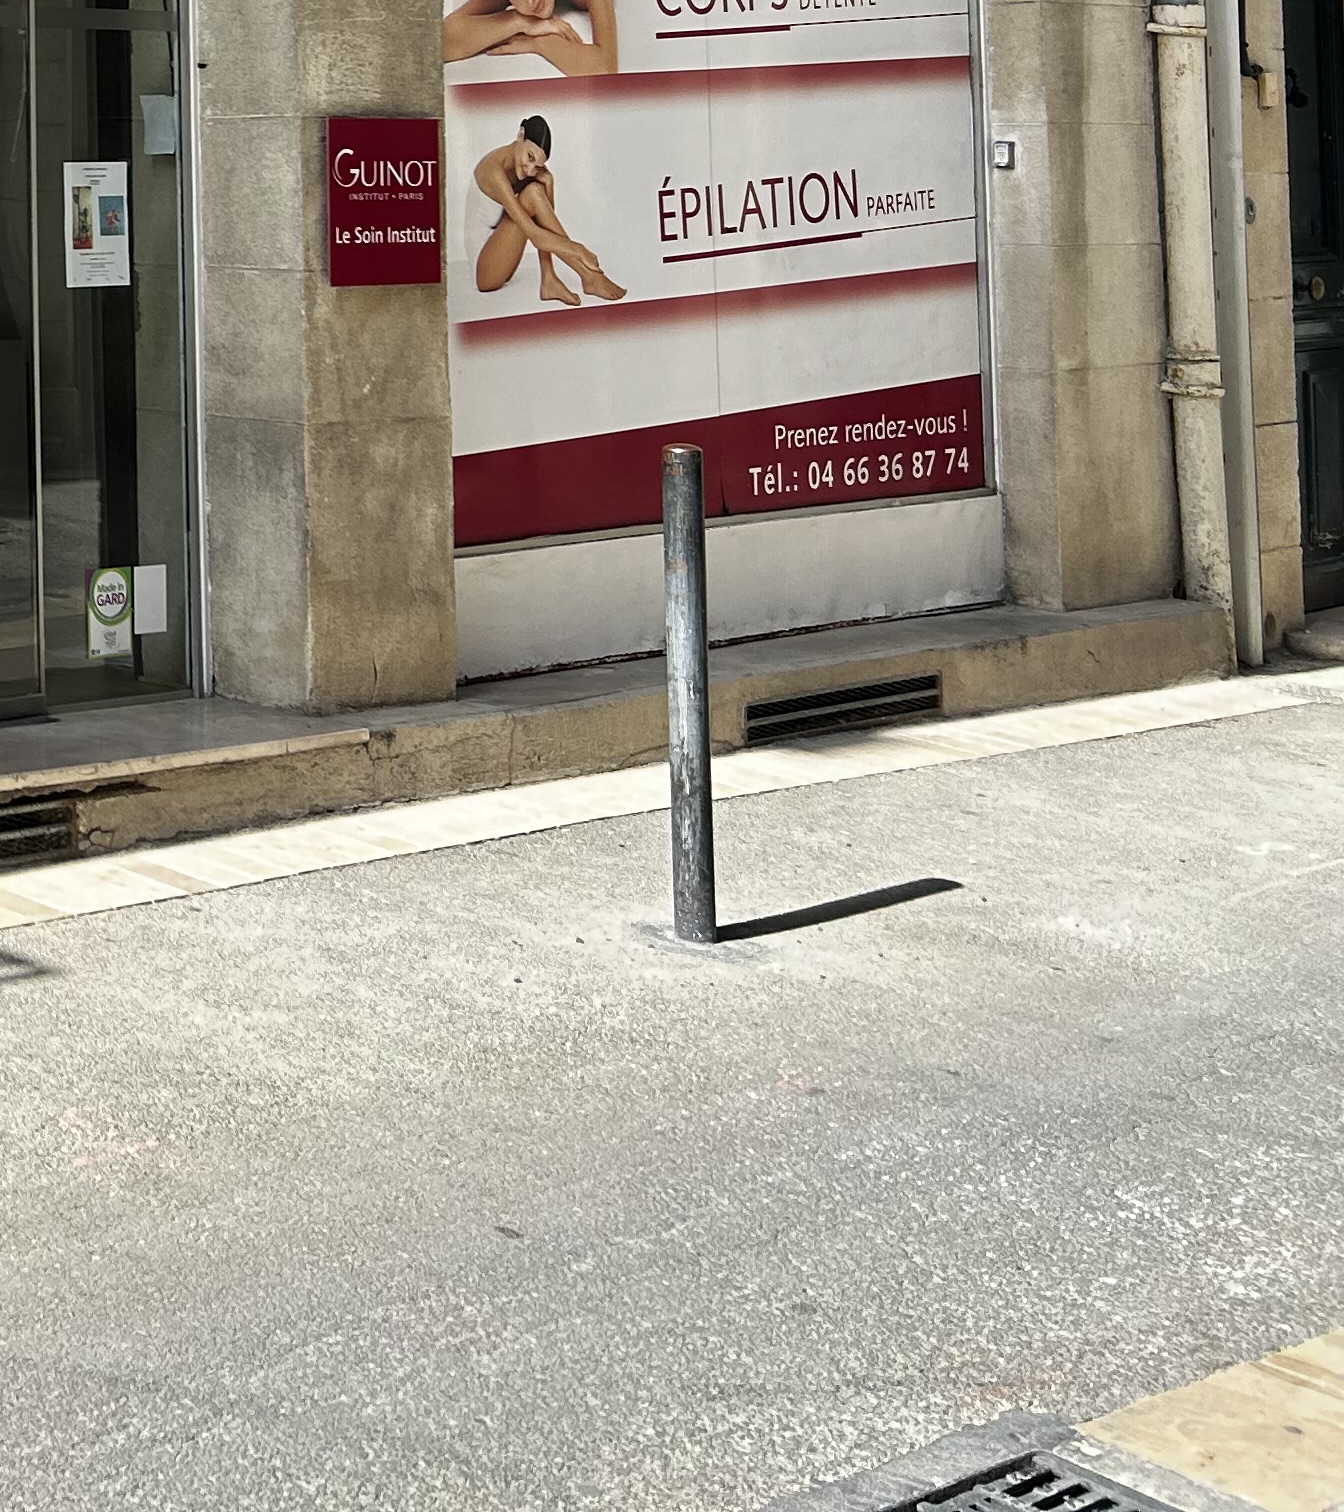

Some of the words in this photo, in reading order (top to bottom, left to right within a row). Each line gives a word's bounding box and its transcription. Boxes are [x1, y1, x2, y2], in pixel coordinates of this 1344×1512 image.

[332, 148, 437, 188] GUINOT
[348, 193, 389, 201] INSTITUT
[398, 192, 424, 201] PARIS
[657, 168, 859, 242] ÉPILATION
[866, 189, 936, 217] PARFAITE
[336, 226, 351, 244] Le
[354, 226, 383, 243] Soin
[387, 225, 436, 243] Institut
[774, 424, 838, 450] Prenez
[845, 414, 956, 443] rendez-vous
[808, 460, 834, 490] 04
[843, 456, 870, 486] 66
[878, 453, 904, 482] 36
[912, 450, 936, 478] 87
[944, 447, 969, 475] 74
[96, 592, 125, 606] GARD
